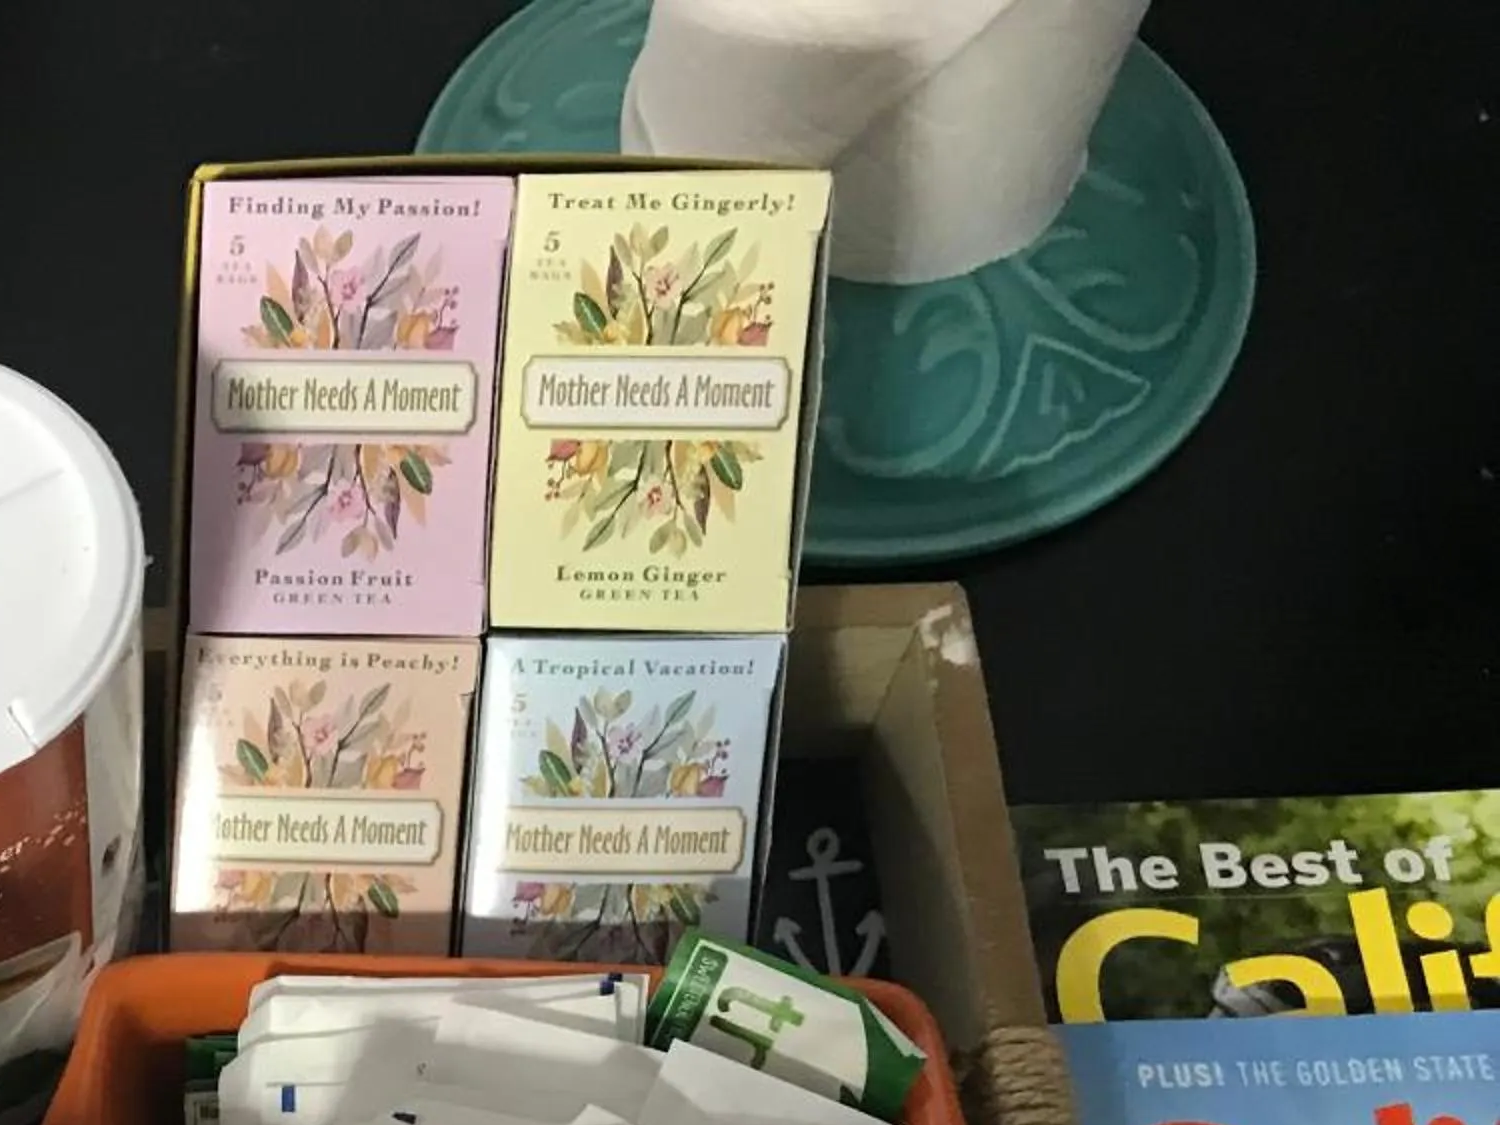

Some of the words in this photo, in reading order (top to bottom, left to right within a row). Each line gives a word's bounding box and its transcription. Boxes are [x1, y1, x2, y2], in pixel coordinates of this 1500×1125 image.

[228, 196, 325, 221] Finding
[333, 197, 370, 220] My
[377, 198, 482, 217] Passion!
[548, 193, 615, 210] Treat
[626, 193, 662, 211] Me
[671, 193, 796, 217] Gingerly!
[229, 234, 245, 257] 5
[543, 230, 561, 253] 5
[227, 377, 299, 411] Mother
[304, 378, 357, 412] Needs
[363, 378, 377, 411] A
[382, 379, 462, 413] Moment
[538, 373, 611, 407] Mother
[615, 374, 670, 408] Needs
[675, 374, 689, 408] A
[693, 375, 775, 409] Moment
[255, 568, 343, 586] Passion
[351, 569, 414, 587] Fruit
[556, 565, 634, 582] Lemon
[642, 564, 727, 587] Ginger
[273, 593, 343, 605] GREEN
[354, 593, 392, 605] TEA
[579, 588, 651, 601] GREEN
[662, 588, 699, 601] TEA
[341, 652, 359, 668] is
[367, 652, 460, 674] Peachy!
[511, 658, 525, 673] A
[533, 658, 635, 679] Tropical
[644, 660, 755, 677] Vacation!
[511, 693, 527, 712] 5
[277, 813, 330, 844] Needs
[333, 815, 347, 844] A
[351, 815, 429, 846] Moment
[506, 822, 574, 854] Mother
[579, 823, 632, 854] Needs
[637, 825, 650, 854] A
[654, 825, 731, 855] Moment
[1044, 846, 1179, 893] The
[1199, 839, 1363, 889] Best
[1384, 835, 1453, 883] of
[1137, 1061, 1225, 1089] PLUS!
[1236, 1059, 1284, 1087] THE
[1295, 1056, 1404, 1086] GOLDEN
[1416, 1053, 1495, 1082] STATE
